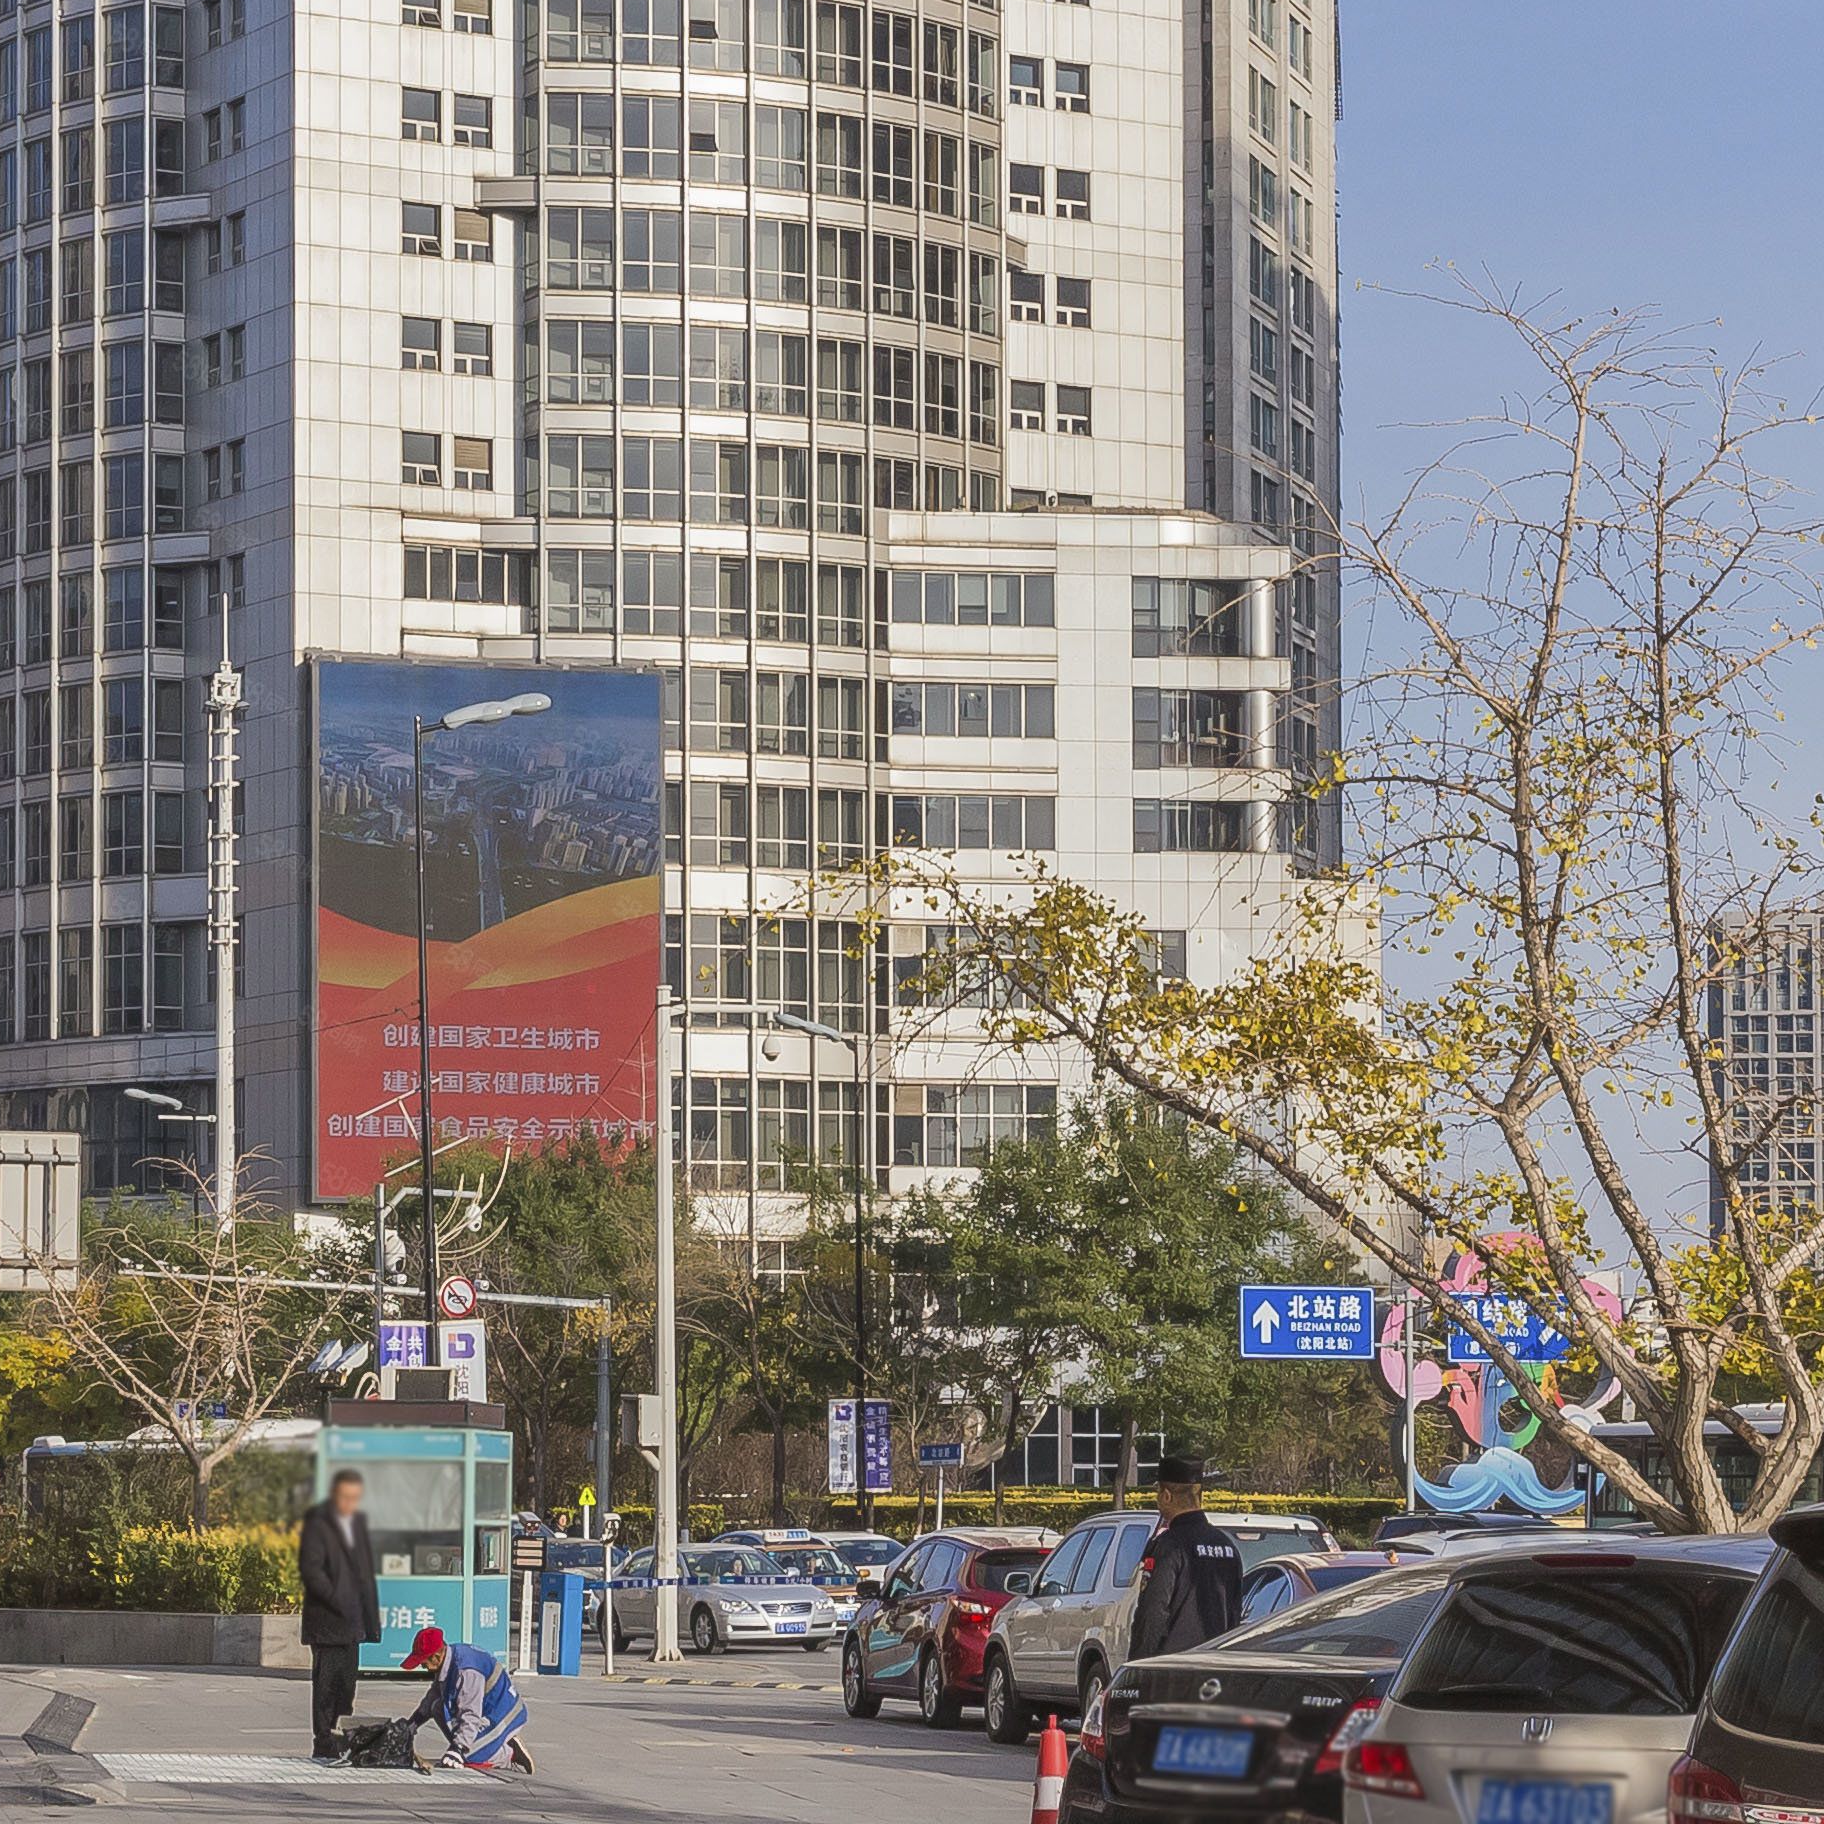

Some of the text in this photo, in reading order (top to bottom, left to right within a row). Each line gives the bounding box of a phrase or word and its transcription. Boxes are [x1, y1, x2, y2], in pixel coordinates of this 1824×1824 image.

[383, 1023, 600, 1051] 创建国家卫生城市
[1287, 1295, 1362, 1320] 北站路
[1291, 1322, 1361, 1333] BEIZHAN ROAD
